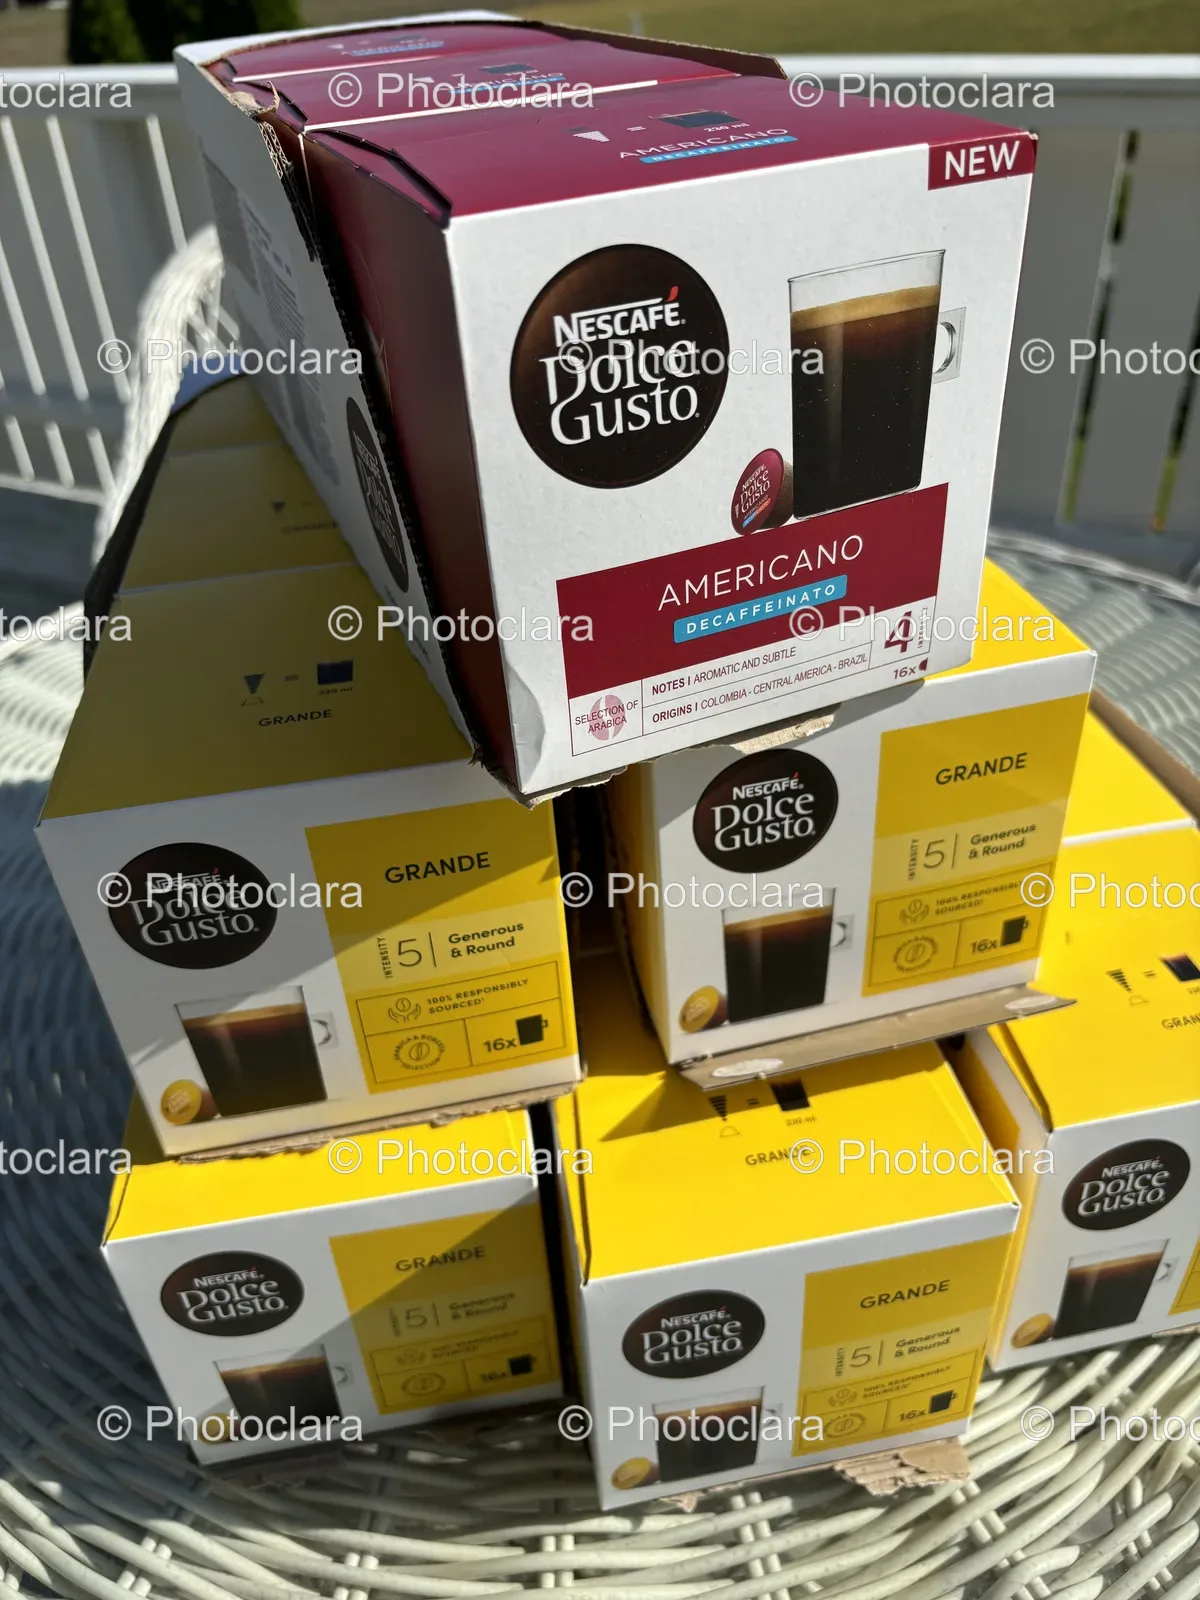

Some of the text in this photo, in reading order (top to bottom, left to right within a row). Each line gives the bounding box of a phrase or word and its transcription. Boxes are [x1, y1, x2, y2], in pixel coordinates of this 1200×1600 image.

[620, 128, 788, 159] AMERICANO
[945, 141, 1020, 180] NEW
[539, 338, 697, 405] Dolce
[550, 380, 699, 446] Gusto
[740, 470, 769, 505] Dolce
[741, 481, 770, 513] Gusto
[658, 535, 863, 611] AMERICANO
[686, 583, 836, 635] DECAFFEINATO
[884, 611, 912, 653] 4
[652, 677, 686, 696] NOTES
[693, 660, 740, 684] AROMATIC
[740, 656, 761, 672] AND
[762, 646, 797, 666] SUBTLE
[893, 665, 917, 679] 16x
[652, 703, 693, 724] ORIGINS
[701, 689, 748, 711] COLOMBIA
[753, 678, 793, 699] CENTRAL
[794, 669, 832, 688] AMERICA
[838, 653, 868, 673] BRAZIL
[258, 708, 333, 727] GRANDE
[575, 698, 639, 727] SELECTION OF
[587, 715, 628, 734] ARABICA
[935, 752, 1028, 785] GRANDE
[733, 772, 799, 800] NESCAFÉ
[711, 793, 815, 831] Dolce
[714, 816, 815, 851] Gusto
[968, 837, 1025, 860] & Round
[970, 823, 1036, 845] Generous
[385, 851, 491, 885] GRANDE
[908, 838, 919, 880] INTENSITY
[923, 838, 946, 869] 5
[127, 889, 249, 926] Dolce
[141, 912, 255, 947] Gusto
[449, 922, 524, 944] Generous
[377, 936, 393, 979] INTENSITY
[398, 938, 422, 967] 5
[450, 936, 515, 959] & Round
[970, 938, 999, 954] 16x
[427, 978, 529, 1006] 100% RESPONSIBLY
[483, 1037, 517, 1053] 16x
[745, 1145, 810, 1166] GRANDE
[1081, 1170, 1170, 1201] Dolce
[1077, 1187, 1165, 1217] Gusto
[395, 1245, 486, 1272] GRANDE
[176, 1280, 280, 1309] Dolce
[187, 1295, 285, 1323] Gusto
[860, 1279, 950, 1309] GRANDE
[405, 1306, 428, 1328] 5
[641, 1320, 742, 1351] Dolce
[643, 1337, 743, 1364] Gusto
[896, 1326, 960, 1348] Generous
[907, 1337, 951, 1355] Round
[850, 1346, 872, 1368] 5
[899, 1409, 927, 1422] 16x
